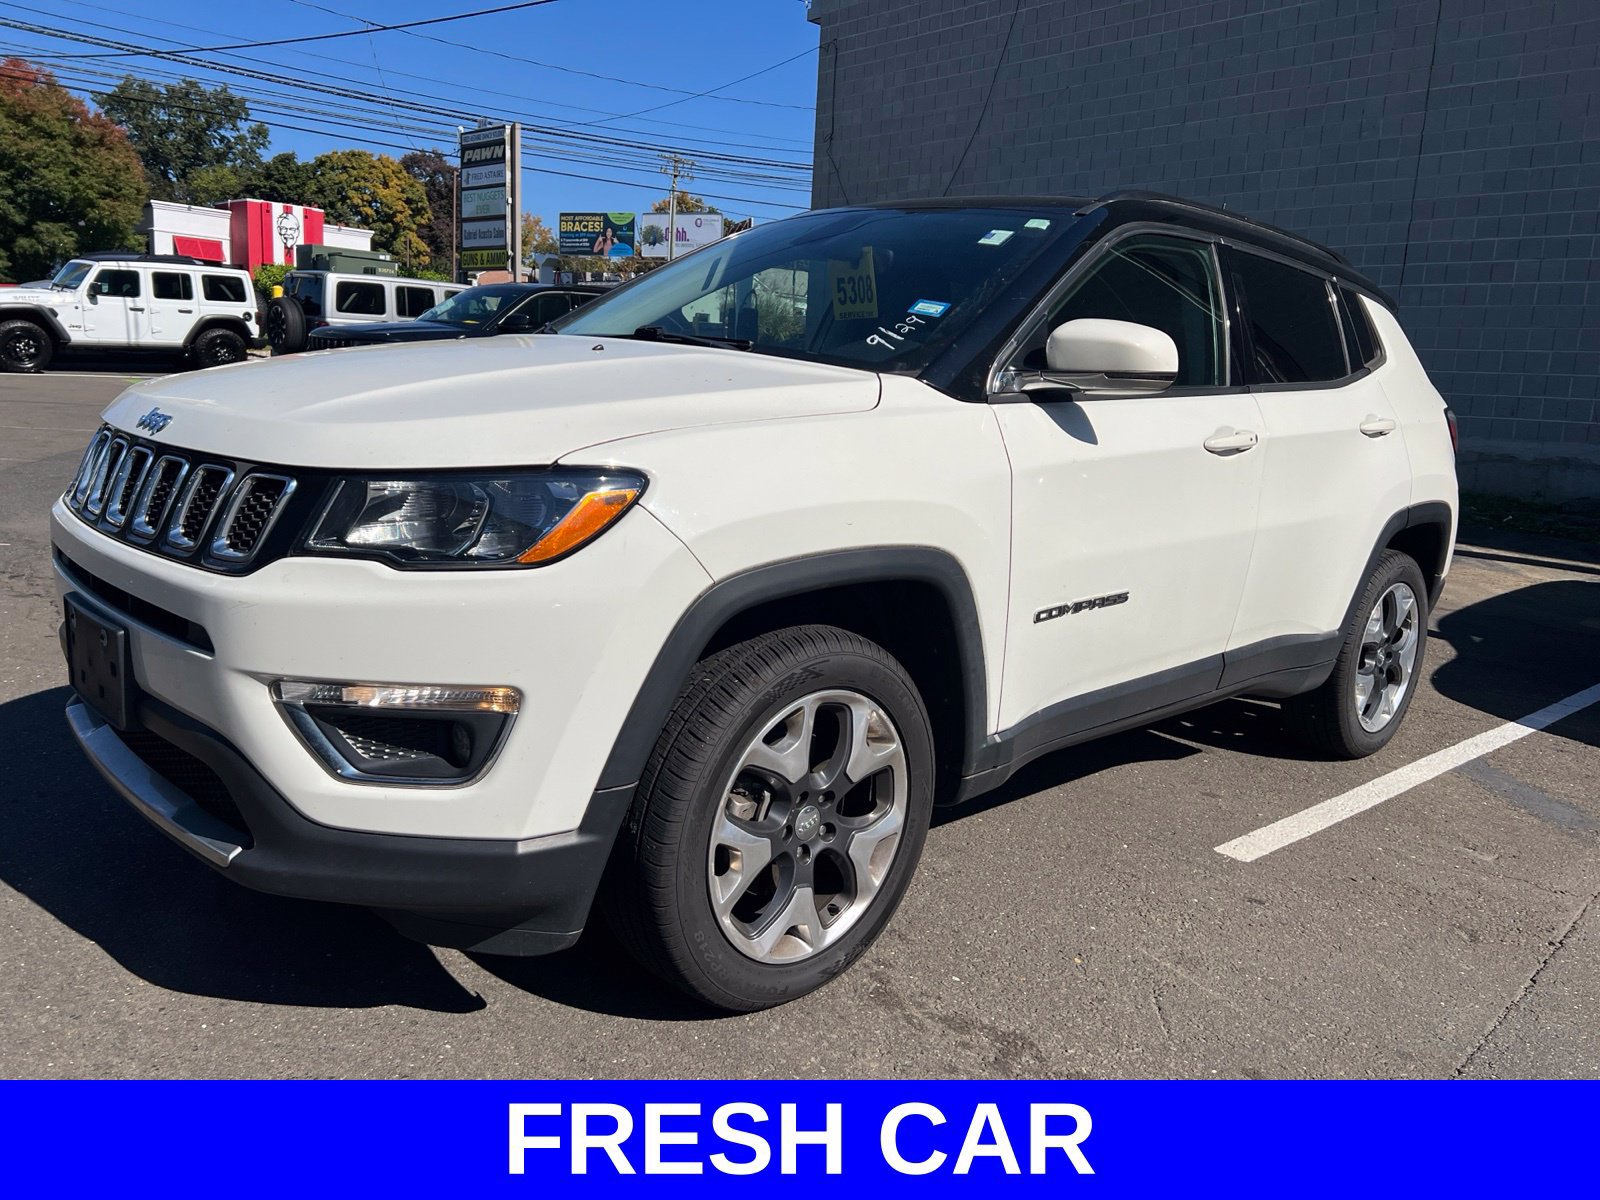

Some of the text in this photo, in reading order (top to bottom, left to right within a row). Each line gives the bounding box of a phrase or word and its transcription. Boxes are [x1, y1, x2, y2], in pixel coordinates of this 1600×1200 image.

[463, 145, 504, 162] PAWN
[472, 170, 504, 181] FRED ASTAIRE
[464, 189, 505, 204] BEST NUGGETS
[475, 205, 490, 215] EVER
[561, 221, 604, 232] BRACES!
[464, 229, 477, 240] Gabriel
[463, 251, 506, 266] GUNS & AMMO
[837, 275, 874, 305] 5308
[136, 406, 173, 437] Jeep
[1033, 589, 1129, 624] COMPASS
